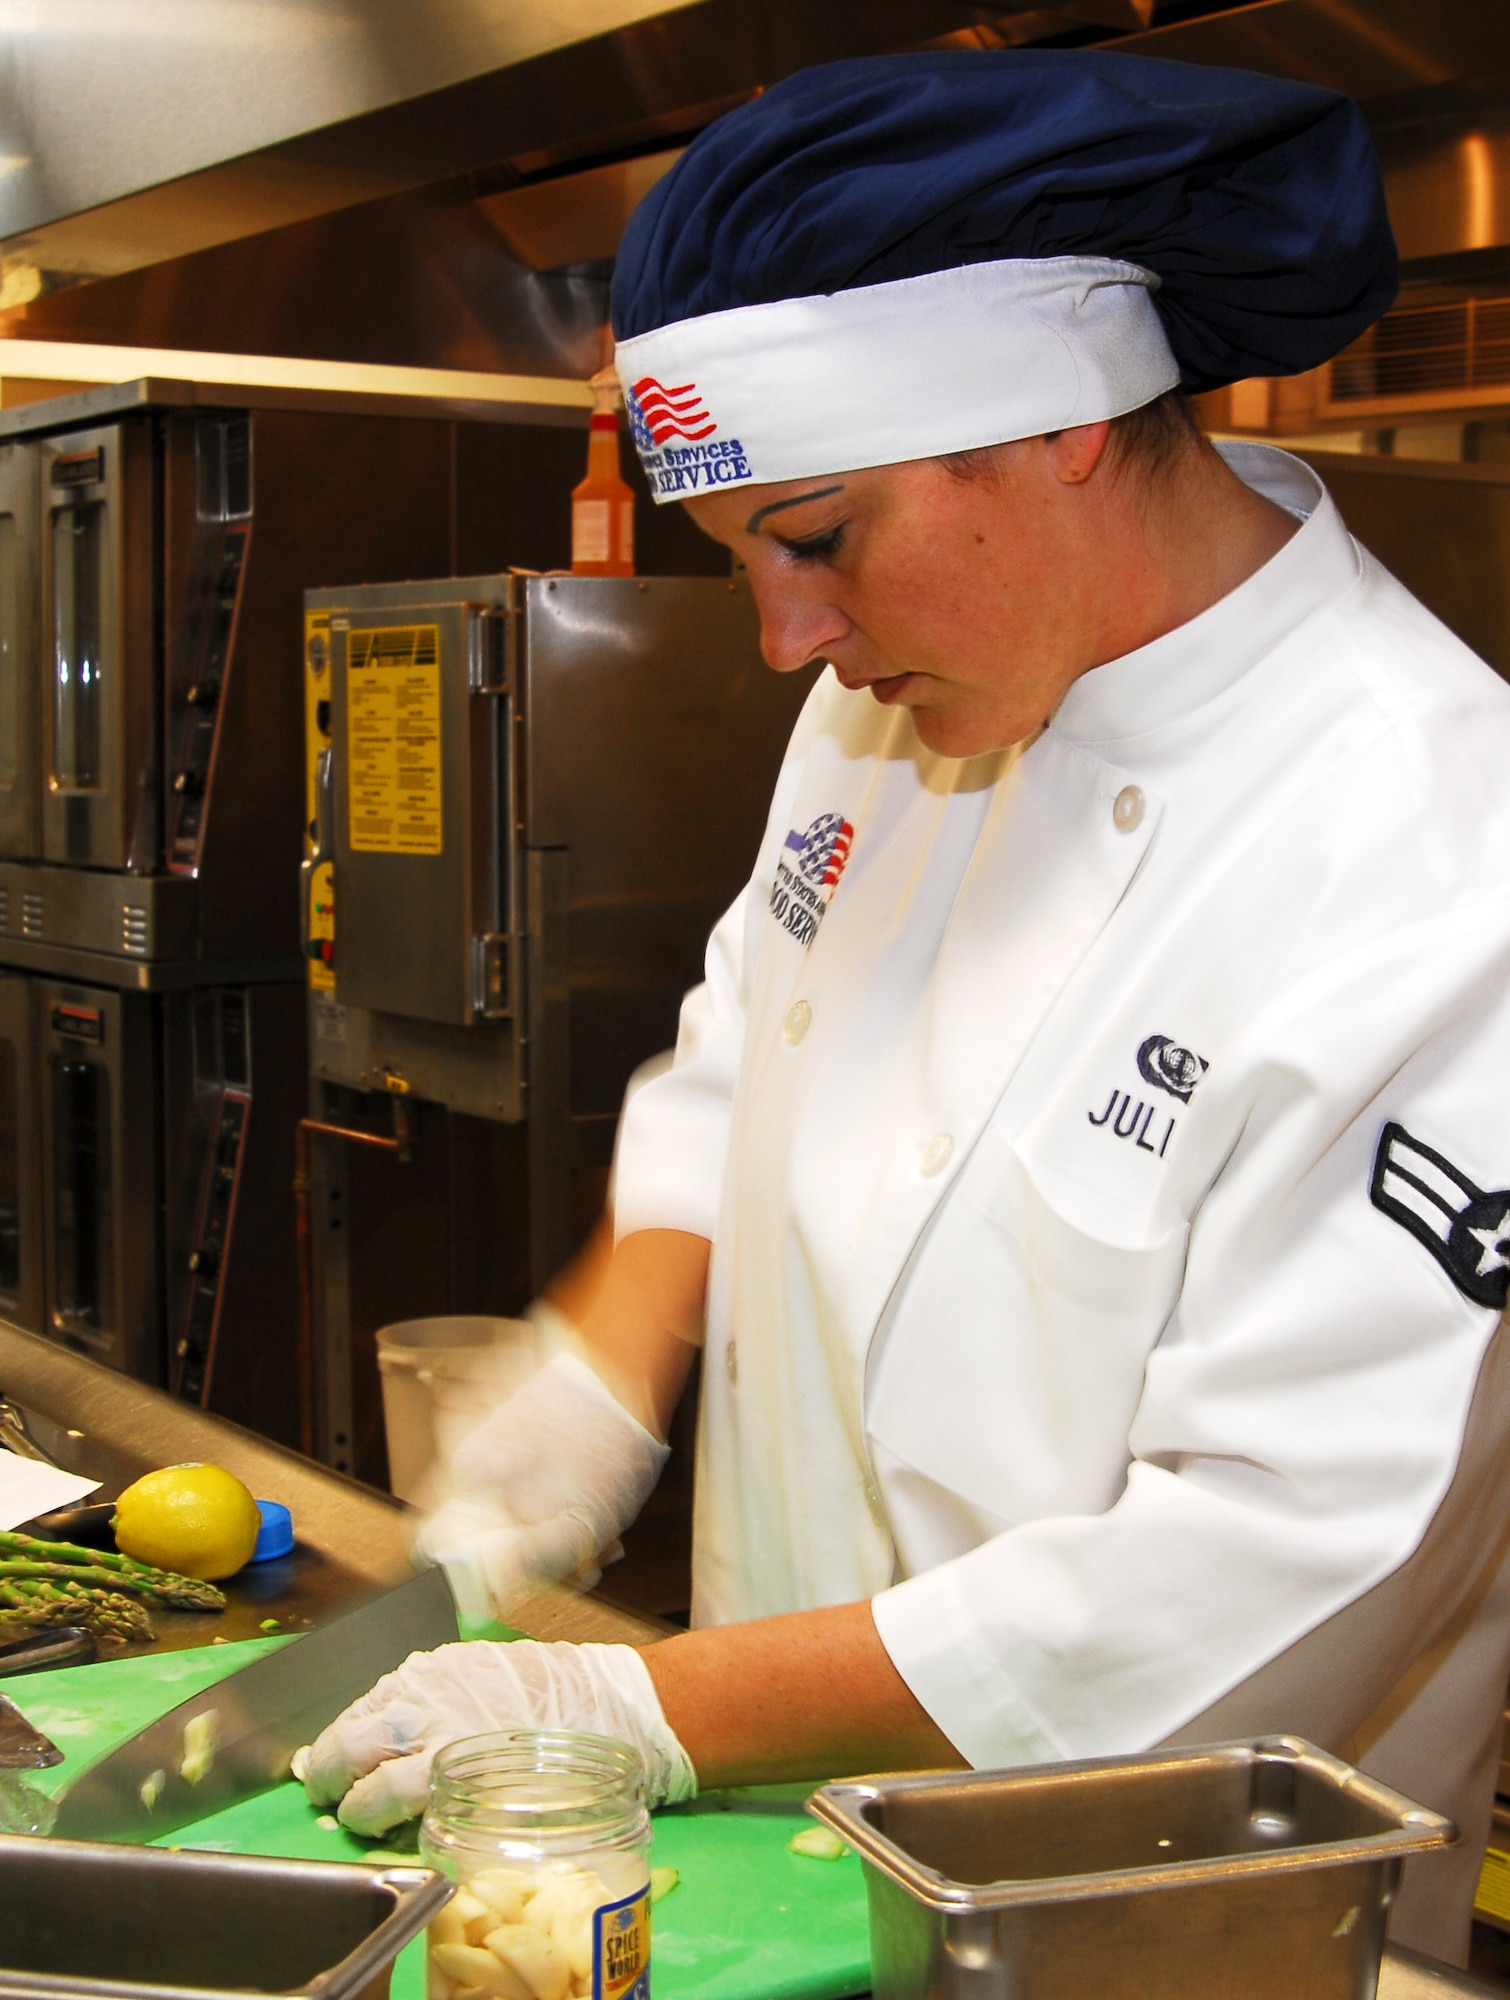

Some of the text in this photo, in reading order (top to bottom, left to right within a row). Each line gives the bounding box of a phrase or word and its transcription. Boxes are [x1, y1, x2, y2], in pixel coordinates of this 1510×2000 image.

[663, 439, 744, 467] SERVICES
[659, 456, 753, 494] SERVICE
[1088, 1089, 1175, 1158] JULI
[606, 1927, 640, 1961] SPICE
[607, 1951, 641, 1980] WORLD
